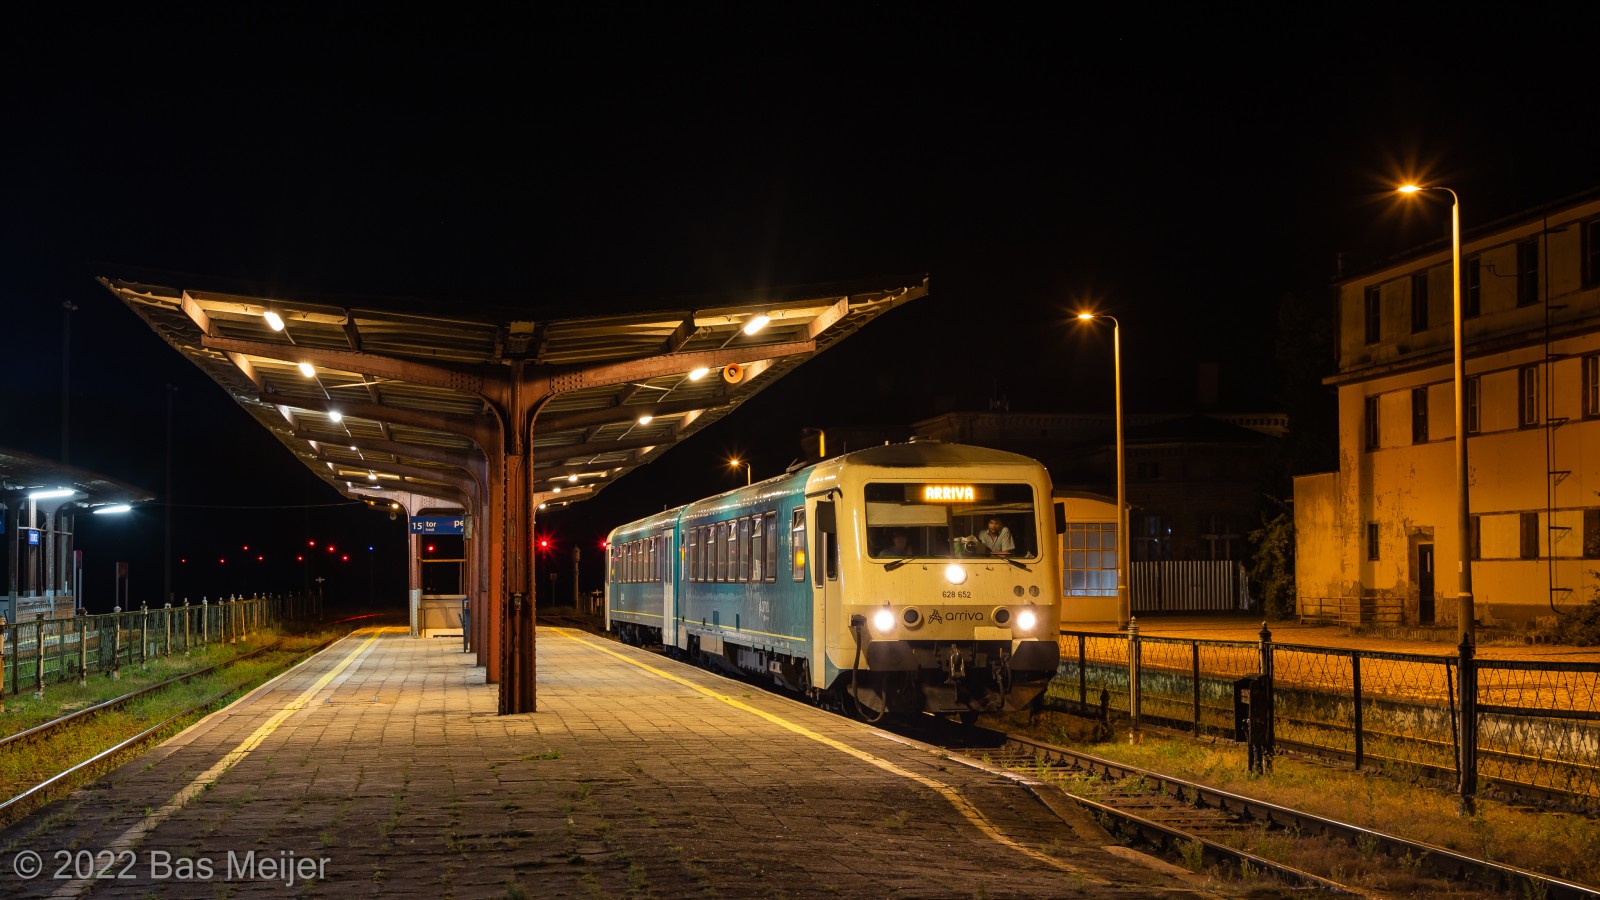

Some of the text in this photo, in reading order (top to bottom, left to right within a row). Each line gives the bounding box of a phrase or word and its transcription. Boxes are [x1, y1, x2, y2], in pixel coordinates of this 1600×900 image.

[925, 486, 974, 500] ARRIVA
[412, 522, 423, 530] 15
[942, 591, 971, 599] 628 652
[945, 610, 984, 621] arriva
